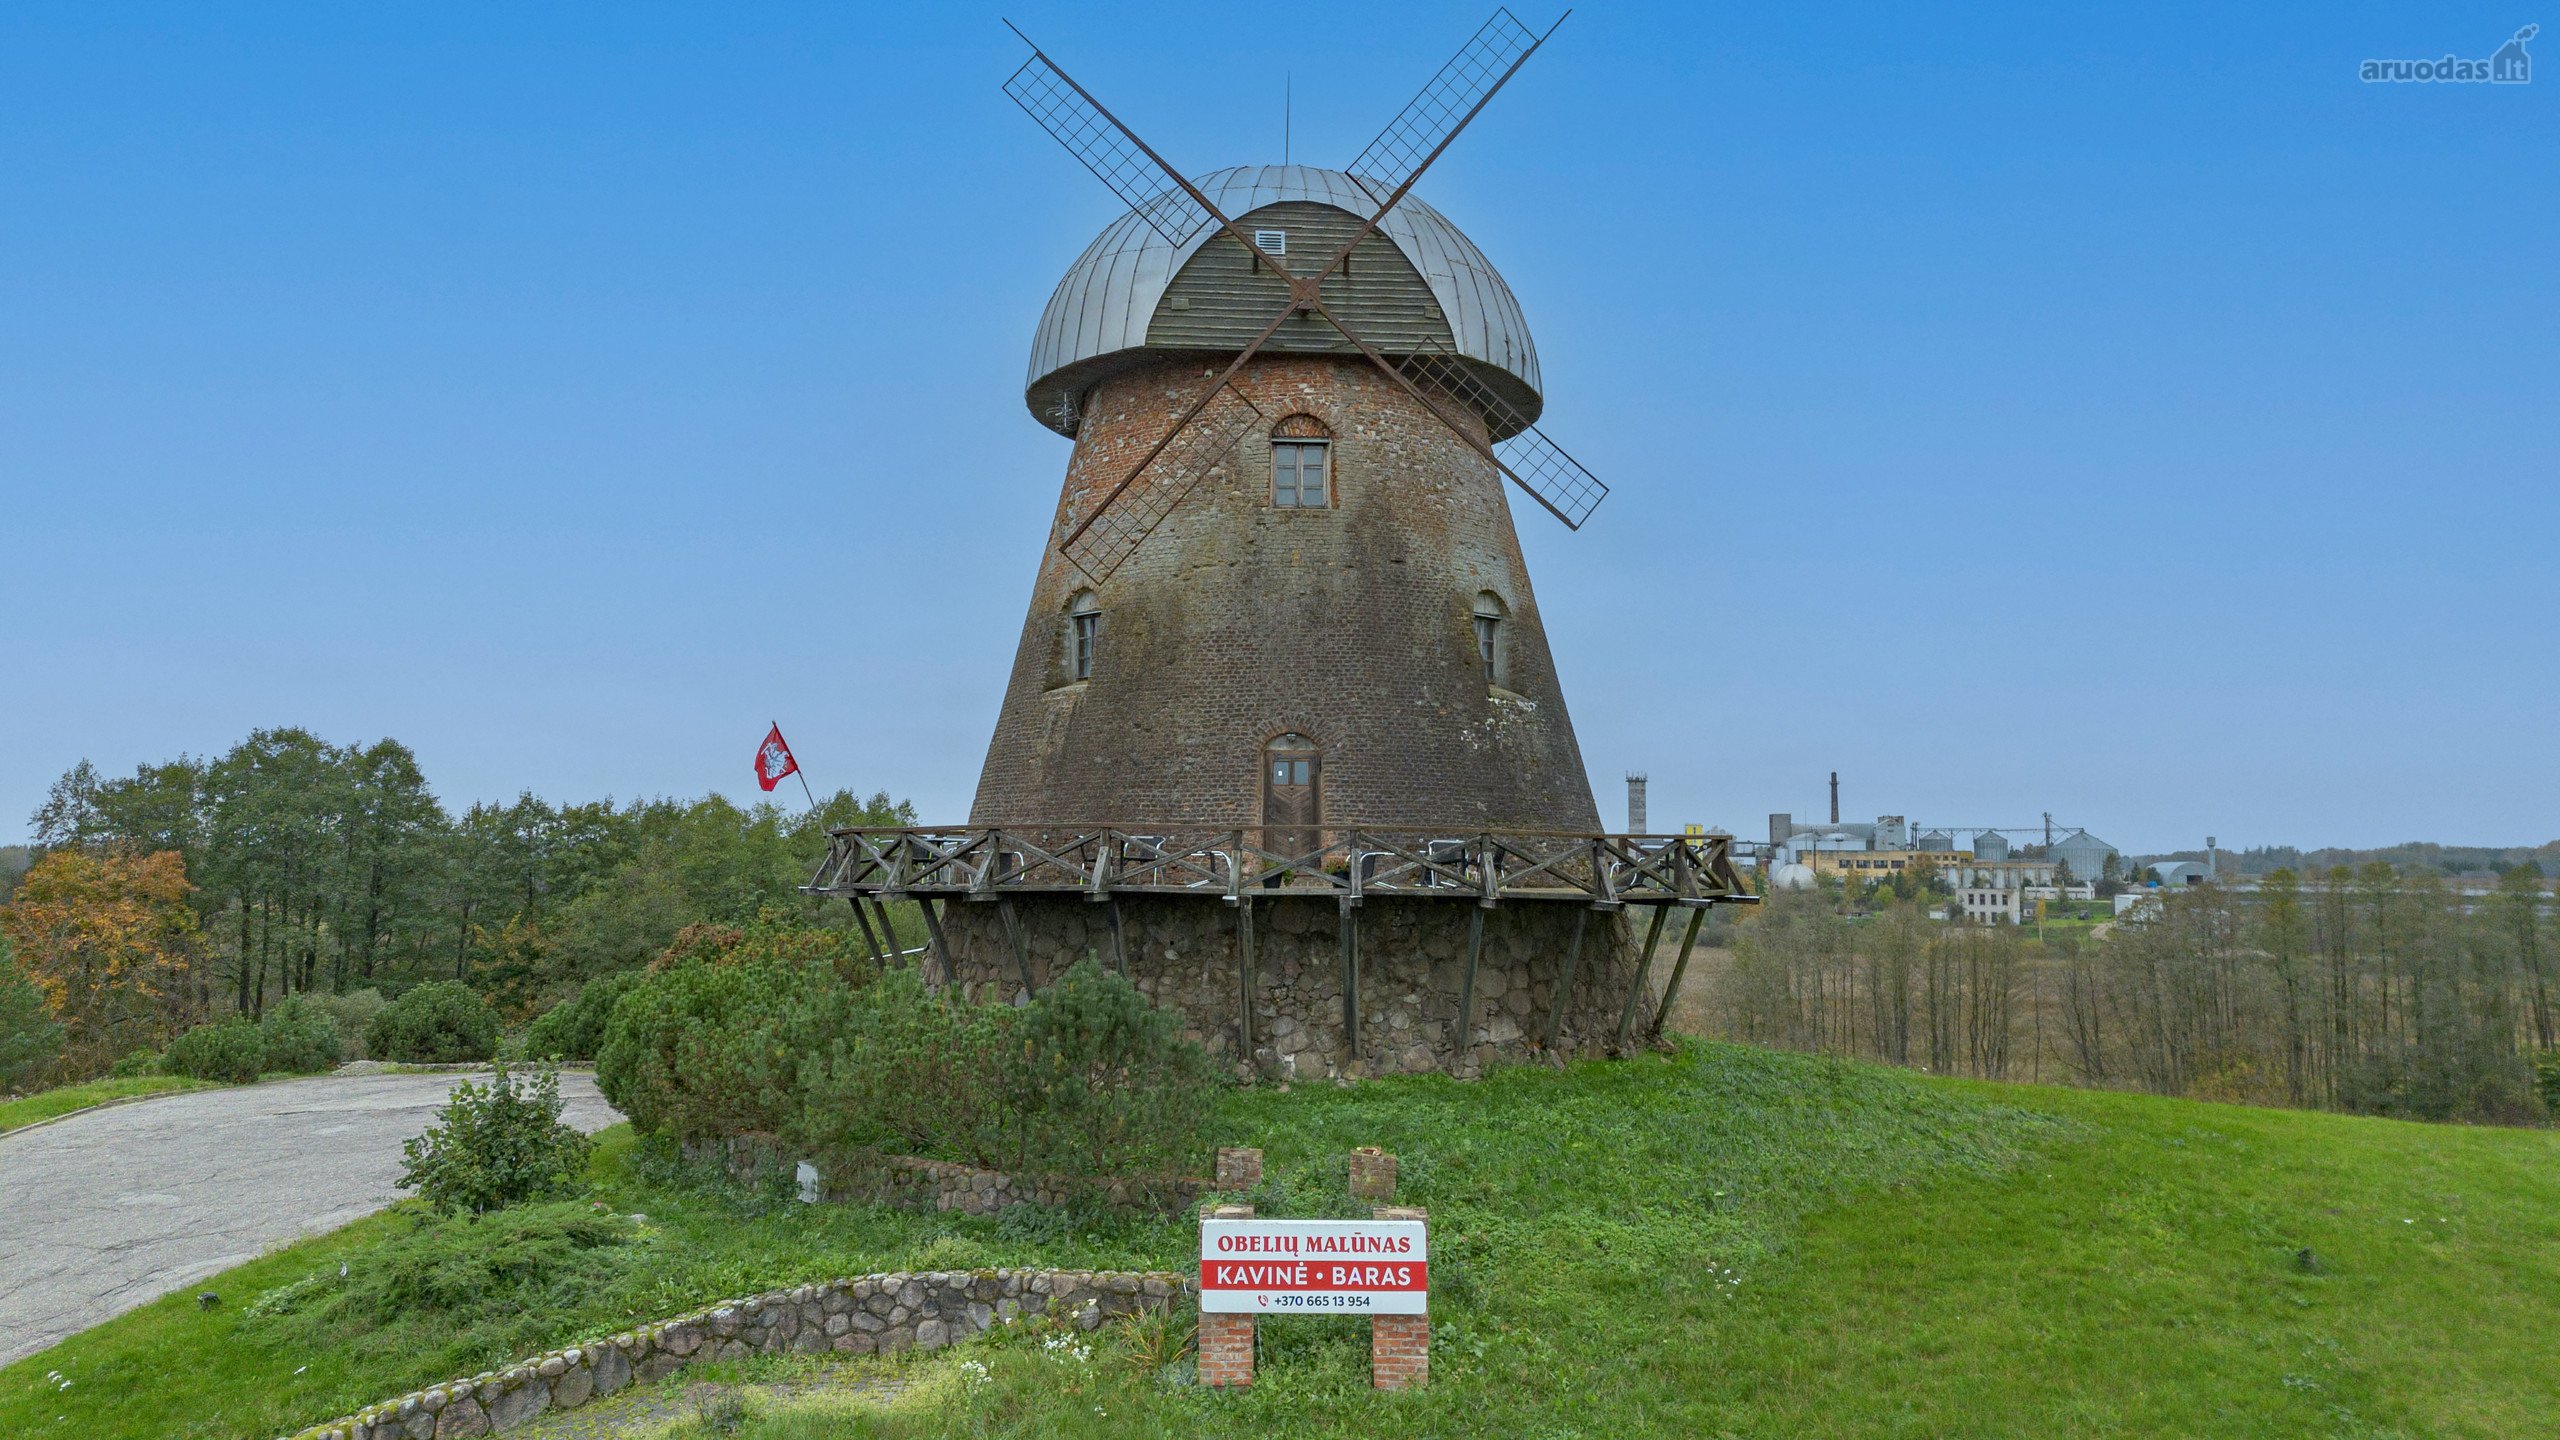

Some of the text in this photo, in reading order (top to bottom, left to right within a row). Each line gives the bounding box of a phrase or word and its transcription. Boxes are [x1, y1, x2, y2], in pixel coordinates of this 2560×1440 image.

[1218, 1232, 1411, 1257] OBELIŲ MALŪNAS
[1217, 1261, 1411, 1285] KAVINĖ BARAS
[1274, 1296, 1370, 1306] +370 665 13 954
